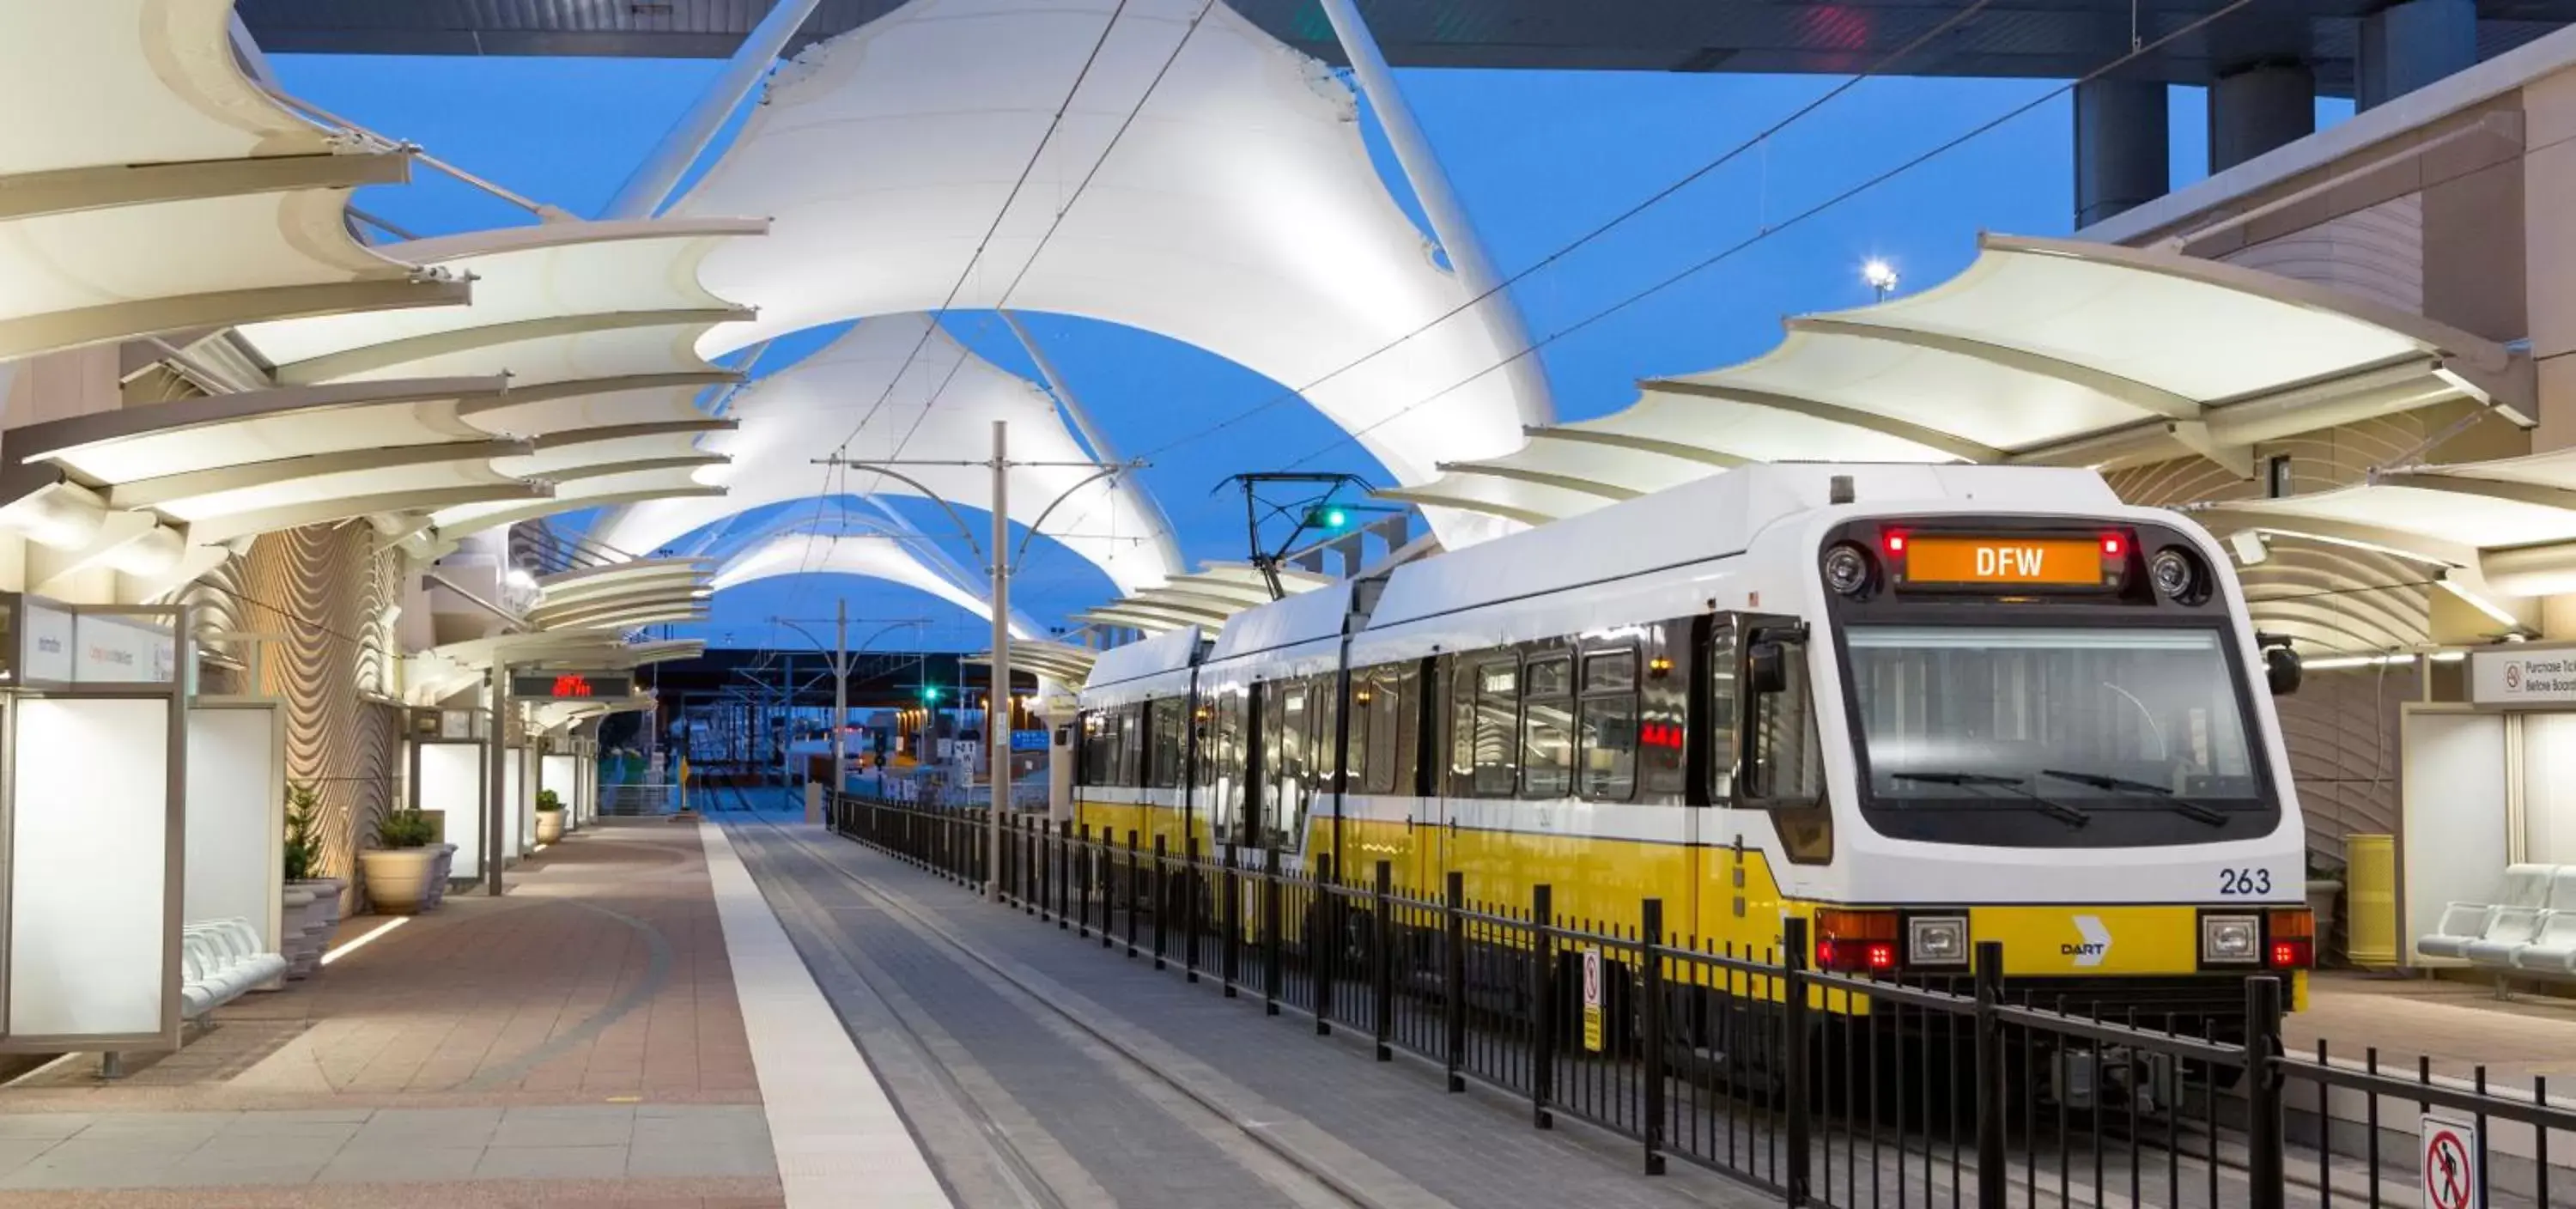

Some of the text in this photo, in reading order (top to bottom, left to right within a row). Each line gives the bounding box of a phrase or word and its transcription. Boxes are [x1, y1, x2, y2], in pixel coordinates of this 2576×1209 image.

[1977, 547, 2044, 577] DFW
[2525, 660, 2561, 674] Purchase
[2525, 679, 2551, 691] Before
[2220, 868, 2271, 895] 263
[2061, 944, 2105, 955] DART
